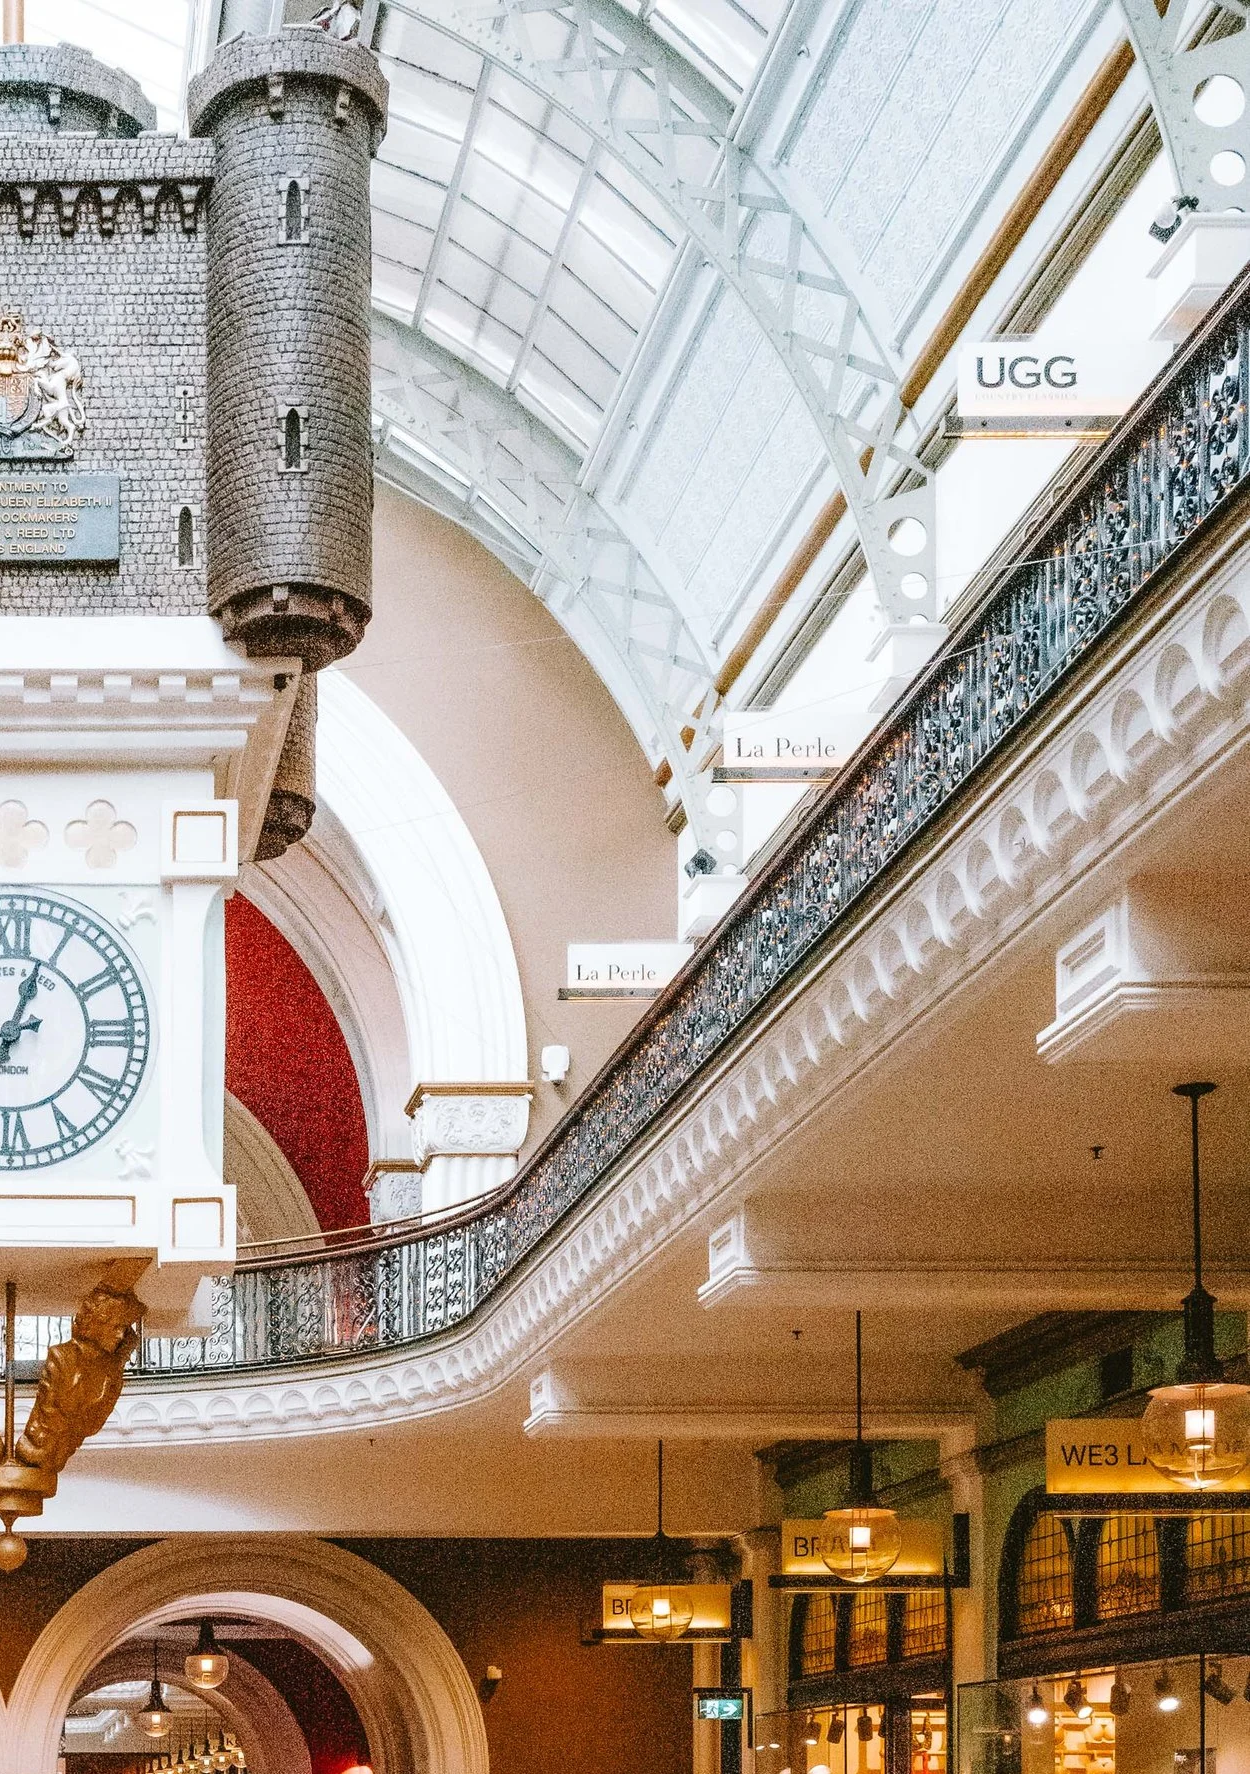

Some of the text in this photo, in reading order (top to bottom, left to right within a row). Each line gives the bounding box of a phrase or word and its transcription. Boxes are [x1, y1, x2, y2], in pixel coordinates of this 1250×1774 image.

[976, 356, 1078, 388] UGG
[52, 482, 69, 493] TO
[36, 496, 101, 508] ELIZABETH
[105, 496, 112, 507] II
[4, 528, 12, 539] &
[17, 528, 49, 539] REED
[52, 528, 76, 539] LTD
[9, 543, 66, 555] ENGLAND
[736, 736, 836, 758] La Perle
[20, 968, 27, 977] &
[36, 974, 56, 991] EED
[576, 964, 656, 981] La Perle
[1061, 1444, 1119, 1466] WE3
